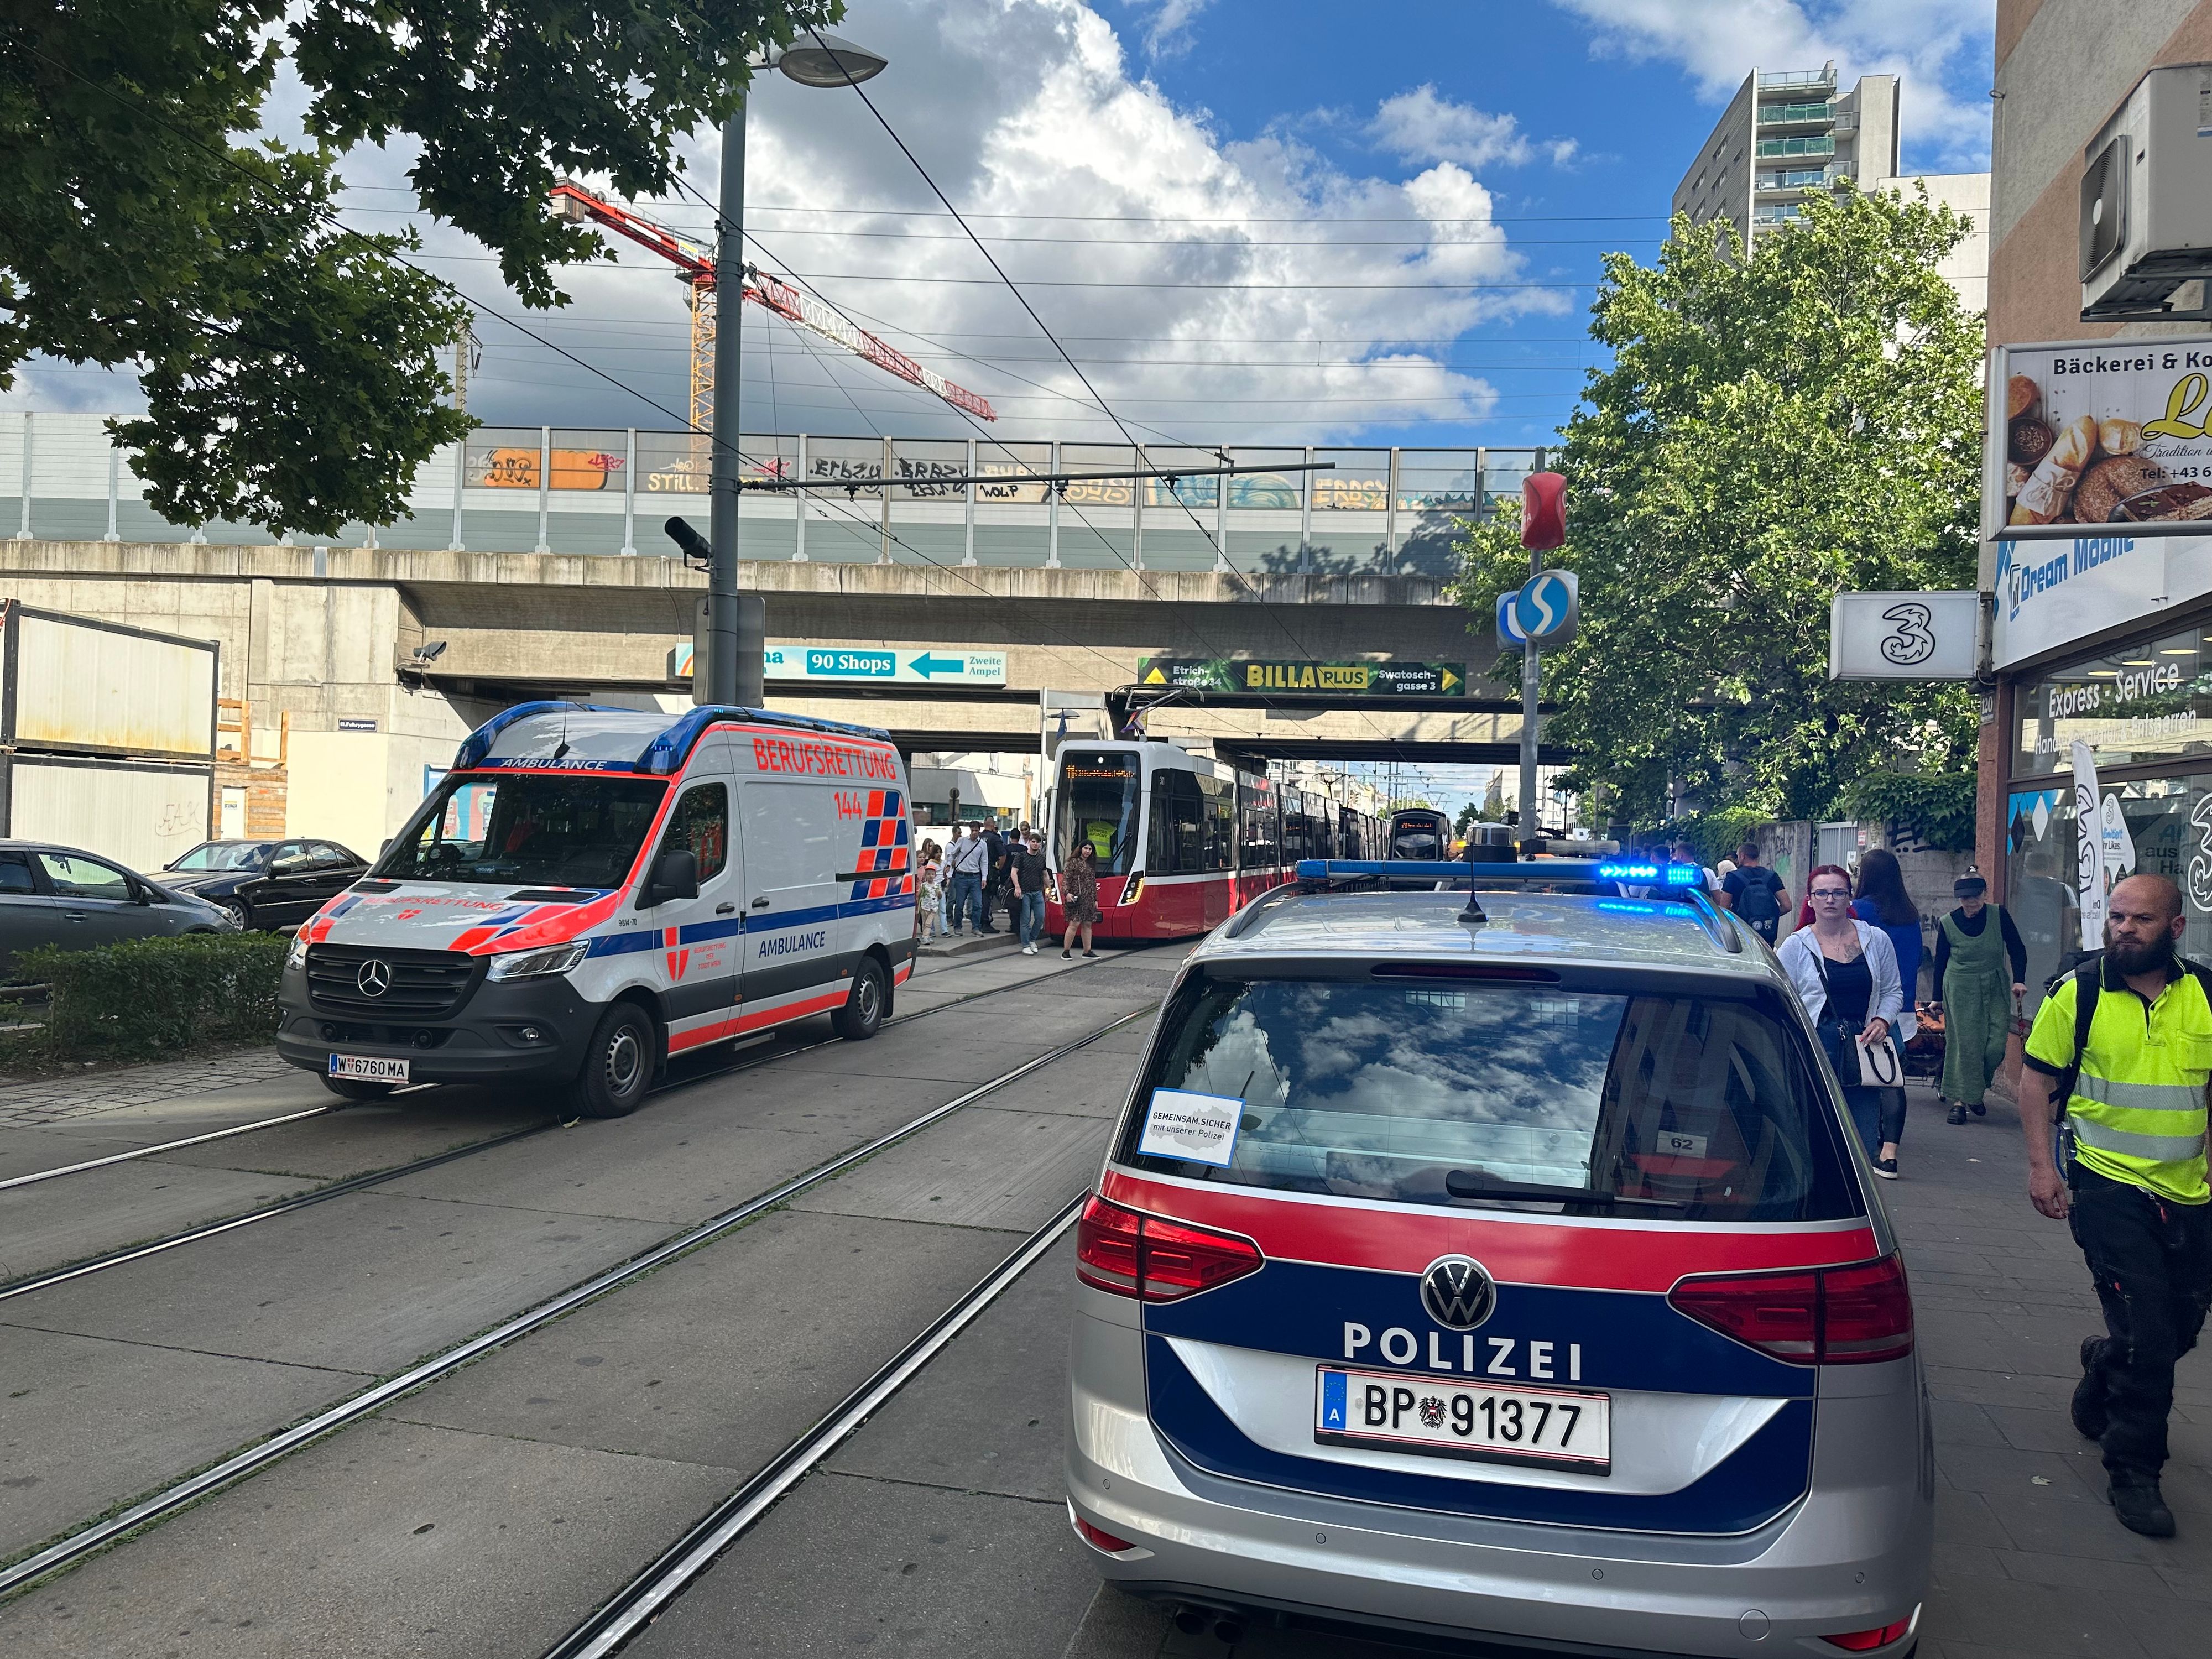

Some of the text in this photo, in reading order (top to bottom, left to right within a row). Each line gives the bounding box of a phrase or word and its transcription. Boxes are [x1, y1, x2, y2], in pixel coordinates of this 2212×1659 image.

[2054, 353, 2154, 375] Bäckerei
[2162, 353, 2178, 369] &
[2138, 443, 2201, 460] Tradition
[2140, 468, 2166, 479] Tel:
[2170, 467, 2198, 478] +43
[2021, 553, 2068, 602] Dream
[1881, 603, 1936, 665] 3
[811, 654, 834, 669] 90
[838, 654, 891, 674] Shops
[969, 656, 1001, 665] Zweite
[969, 667, 1001, 677] Ampel
[1173, 665, 1209, 675] Etrich-
[1246, 665, 1363, 688] BILLA PLUS
[1379, 670, 1436, 680] Swatosch-
[1173, 677, 1222, 686] straße 34
[1396, 681, 1436, 692] gasse 3
[2048, 684, 2100, 720] Express
[2115, 659, 2179, 703] Service
[2132, 709, 2197, 738] Entsperren
[500, 758, 607, 770] AMBULANCE
[753, 738, 896, 780] BERUFSRETTUNG
[834, 791, 863, 820] 144
[2145, 847, 2178, 858] aus
[618, 918, 638, 927] 9814-70
[758, 931, 826, 958] AMBULANCE
[338, 1057, 405, 1077] W 6760 MA
[1153, 1112, 1232, 1130] GEMEINSAM.SICHER
[1166, 1125, 1197, 1136] unserer
[1198, 1129, 1225, 1141] Polizei
[1671, 1138, 1693, 1150] 62
[1344, 1321, 1580, 1381] POLIZEI
[1329, 1408, 1340, 1422] A
[1365, 1384, 1582, 1448] BP 91377
